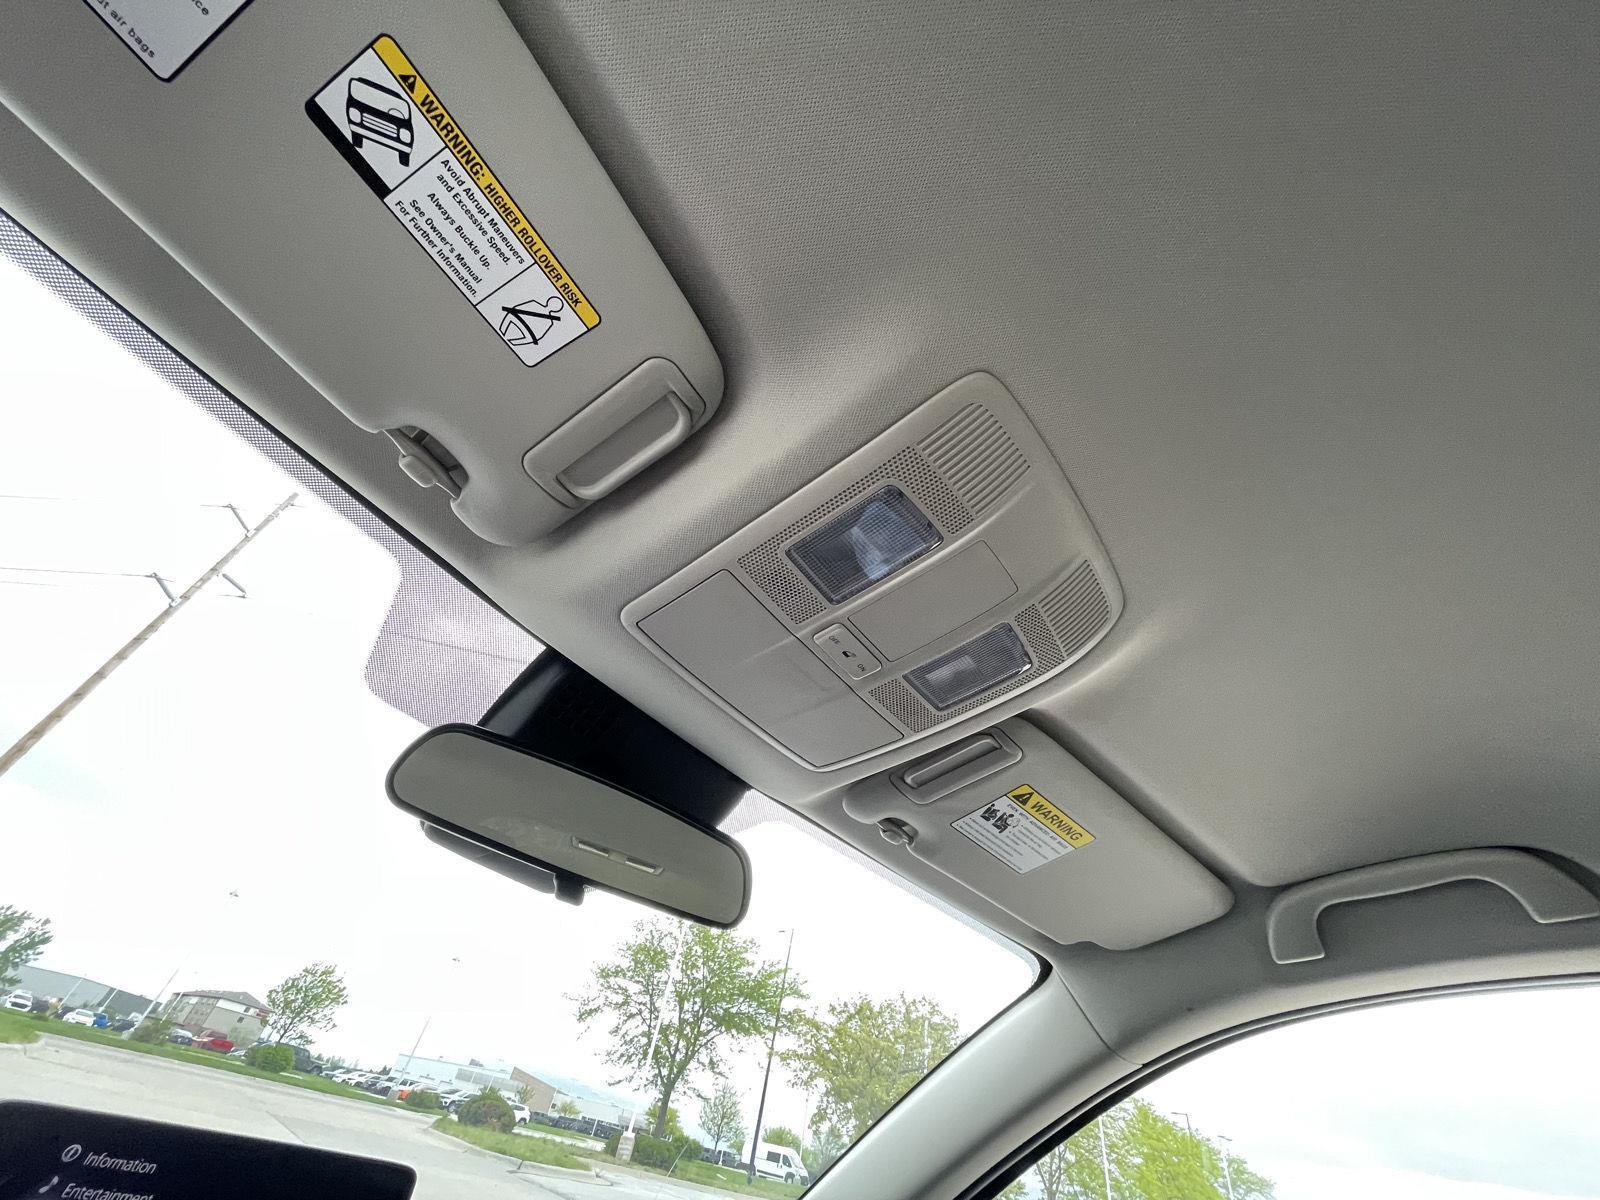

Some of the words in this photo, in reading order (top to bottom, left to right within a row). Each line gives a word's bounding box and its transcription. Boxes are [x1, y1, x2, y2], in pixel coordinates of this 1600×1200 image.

[110, 9, 127, 27] air
[127, 27, 156, 58] bags
[409, 199, 426, 217] See
[424, 218, 456, 253] Owner's
[454, 252, 483, 284] Manual
[420, 93, 485, 180] WARNING:
[484, 182, 520, 228] HIGHER
[518, 227, 563, 283] ROLLOVER
[560, 282, 583, 308] RISK
[427, 193, 456, 225] Always
[454, 225, 480, 255] Buckle
[479, 254, 491, 270] Up.
[436, 174, 455, 193] and
[452, 192, 488, 236] Excessive
[487, 236, 511, 266] Speed.
[441, 160, 466, 187] Avoid
[463, 187, 489, 219] Abrupt
[487, 218, 525, 264] Maneuvers
[395, 200, 411, 216] For
[409, 216, 438, 249] Further
[436, 249, 477, 298] Information.
[1031, 801, 1083, 841] WARNING
[83, 1152, 157, 1175] Information
